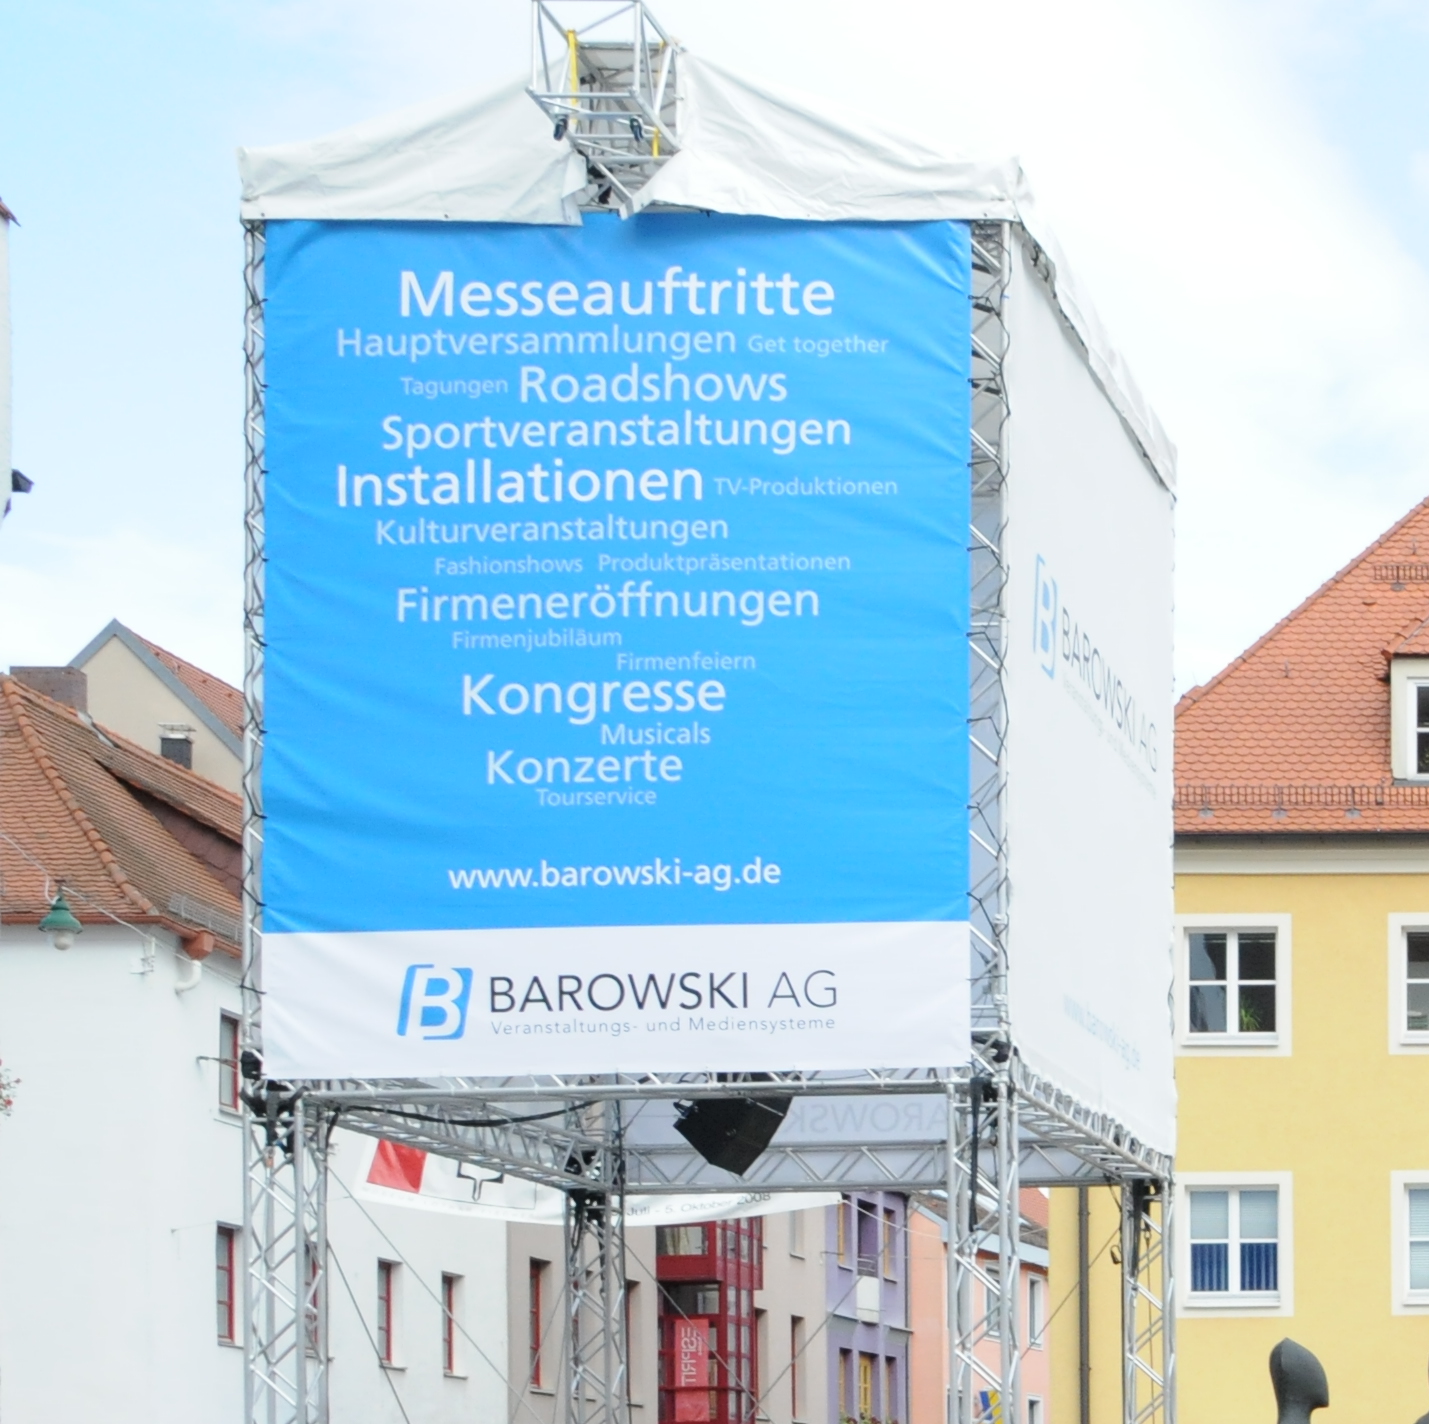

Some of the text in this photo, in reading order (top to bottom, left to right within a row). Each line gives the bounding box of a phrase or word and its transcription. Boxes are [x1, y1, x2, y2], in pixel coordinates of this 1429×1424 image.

[401, 266, 835, 316] Messeauftritte
[338, 324, 888, 362] Hauptversammlungen Get together
[401, 362, 787, 402] Tagungen Roadshows
[383, 410, 851, 458] Sportveranstaltungen
[338, 458, 898, 506] Installationen TV-Produktionen
[377, 514, 728, 546] Kulturveranstaltungen
[435, 553, 851, 575] Fashionshows Produktpräsentationen
[398, 580, 819, 626] Firmeneröffnungen
[453, 628, 622, 652] Firmenjubiläum
[617, 651, 755, 670] Firmenfeiern
[463, 674, 725, 725] Kongresse
[1062, 606, 1135, 750] BAROWSKI
[1138, 713, 1159, 773] AG
[601, 722, 710, 744] Musicals
[488, 750, 682, 784] Konzerte
[536, 787, 656, 806] Tourservice
[448, 857, 781, 891] www.barowski-ag.de
[491, 972, 747, 1012] BAROWSKI
[768, 970, 836, 1008] AG
[491, 1015, 834, 1037] Veranstaltungs- und Mediensysteme
